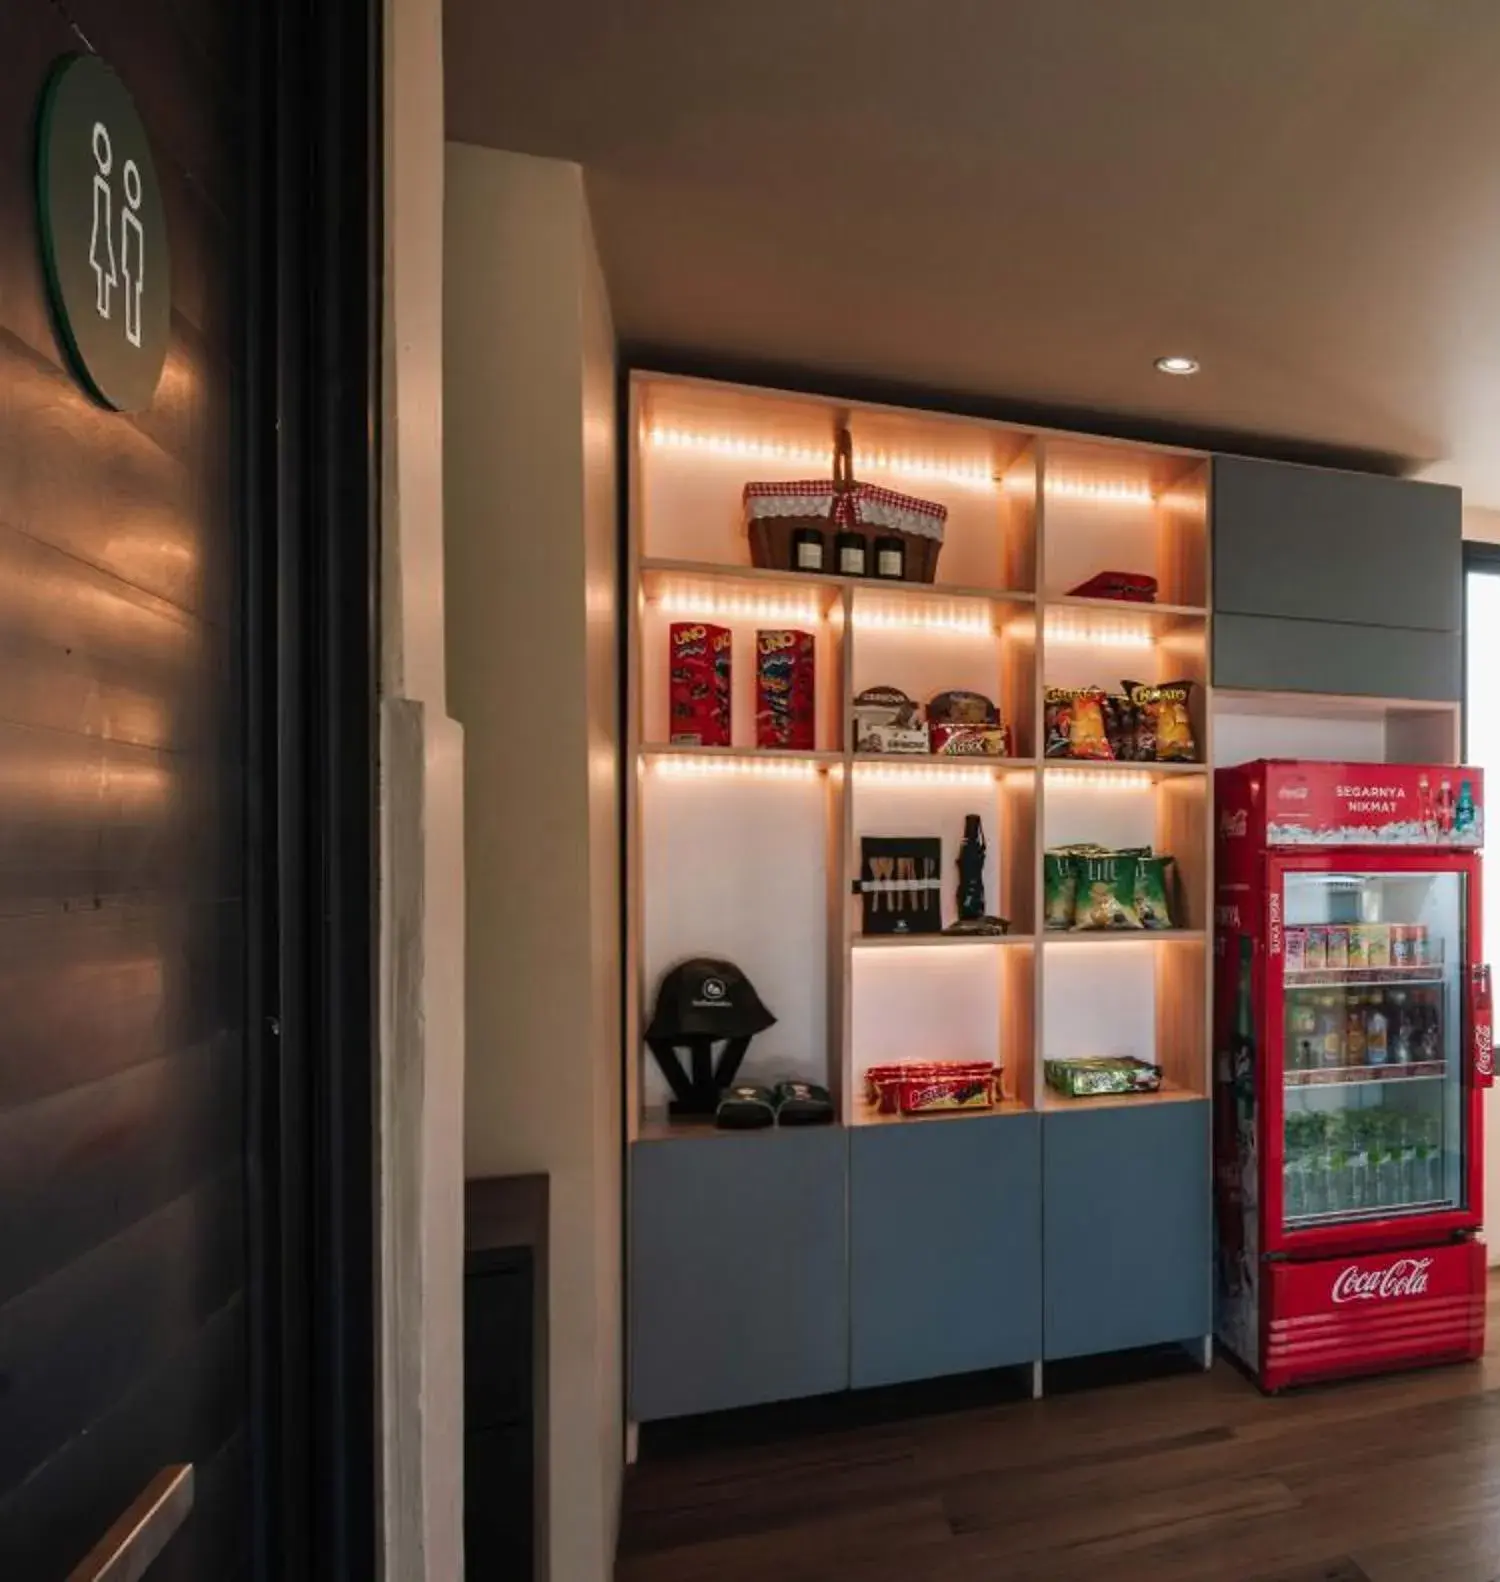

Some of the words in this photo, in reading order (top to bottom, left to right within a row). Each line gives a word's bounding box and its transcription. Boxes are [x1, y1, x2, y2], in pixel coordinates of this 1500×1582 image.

[674, 626, 706, 645] UNO
[759, 632, 795, 654] UNO
[1336, 785, 1406, 798] SEGARNYA
[1348, 801, 1398, 813] NIKMAT
[1331, 1257, 1434, 1303] Coca-Cola
